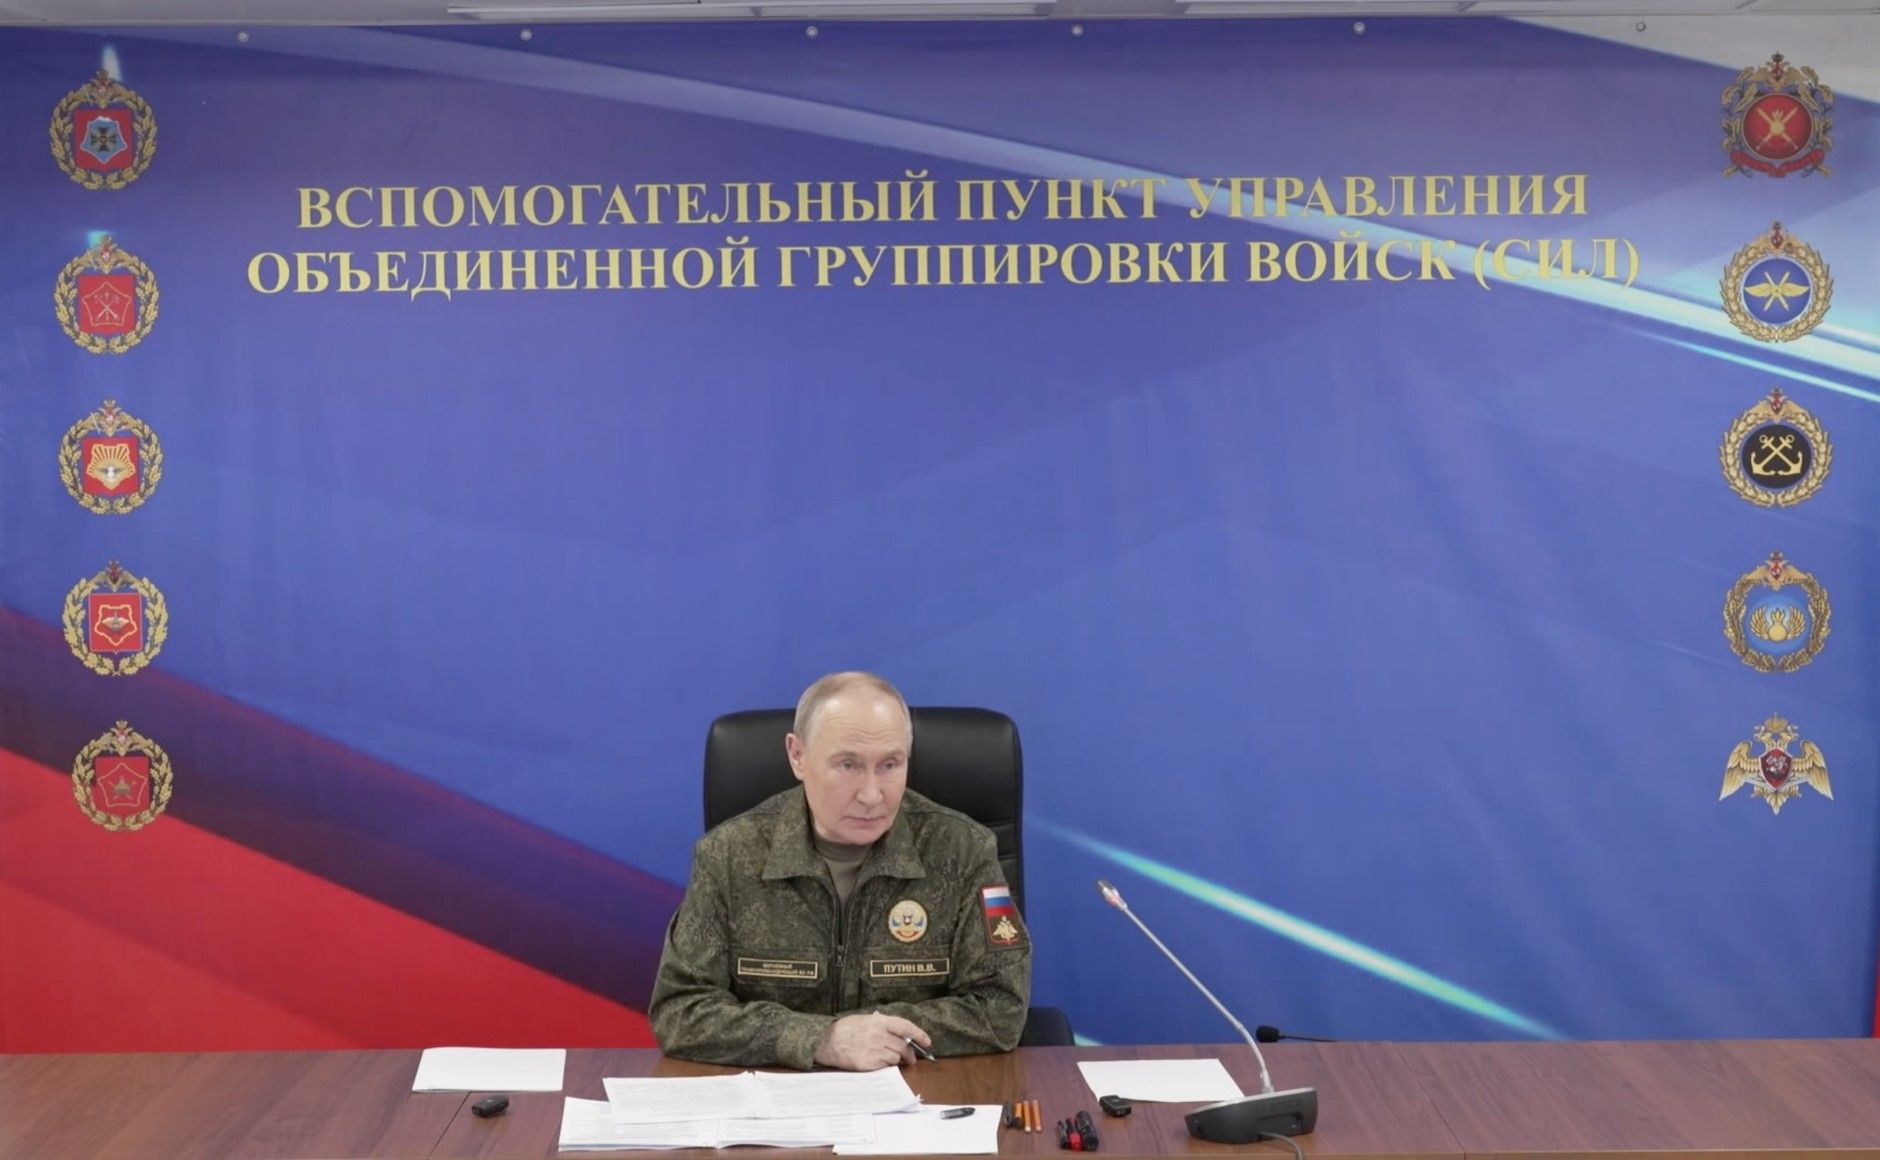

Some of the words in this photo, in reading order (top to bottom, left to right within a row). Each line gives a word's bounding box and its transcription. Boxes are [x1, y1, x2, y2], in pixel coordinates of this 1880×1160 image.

[296, 169, 937, 229] ВСПОМОГАТЕЛЬНЫЙ
[957, 177, 1167, 221] ПУНКТ
[1187, 174, 1588, 219] УПРАВЛЕНИЯ
[246, 236, 757, 302] ОБЪЕДИНЕННОЙ
[778, 243, 1227, 290] ГРУППИРОВКИ
[1246, 230, 1456, 285] ВОЙСК
[1473, 238, 1640, 291] (СИЛ)
[883, 964, 916, 973] ПУТИН
